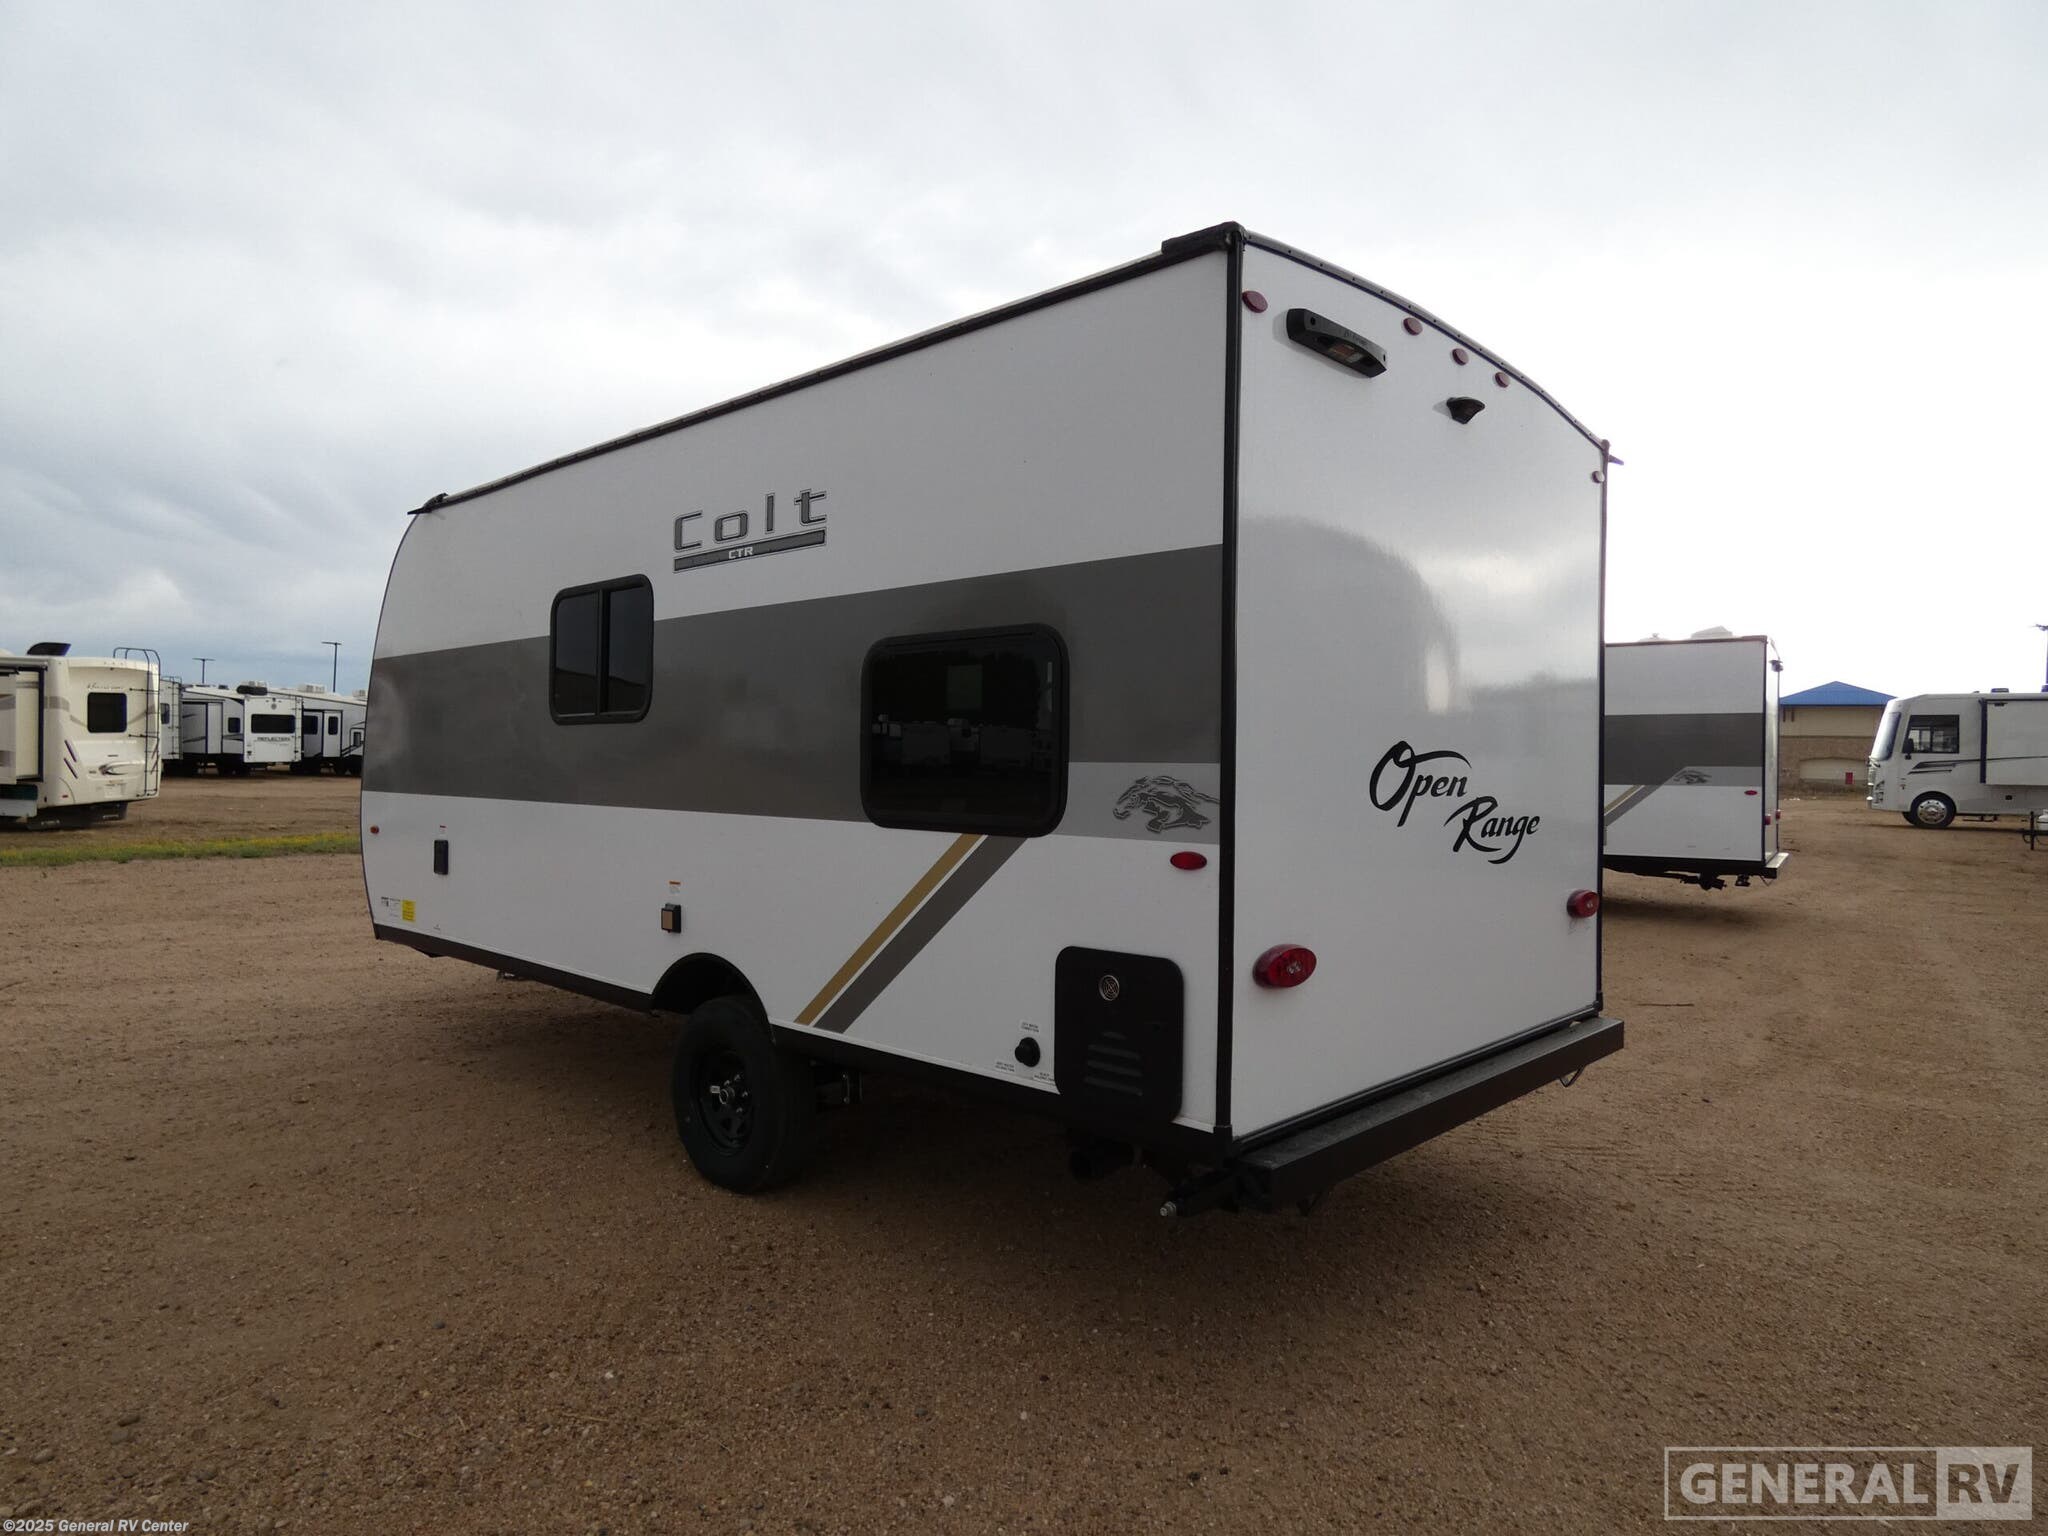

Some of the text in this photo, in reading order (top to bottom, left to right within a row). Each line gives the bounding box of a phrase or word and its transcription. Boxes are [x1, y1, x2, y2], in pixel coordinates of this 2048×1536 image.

[674, 488, 827, 553] Colt
[728, 546, 753, 559] CTR
[1369, 740, 1472, 828] Open
[1443, 795, 1540, 864] Range
